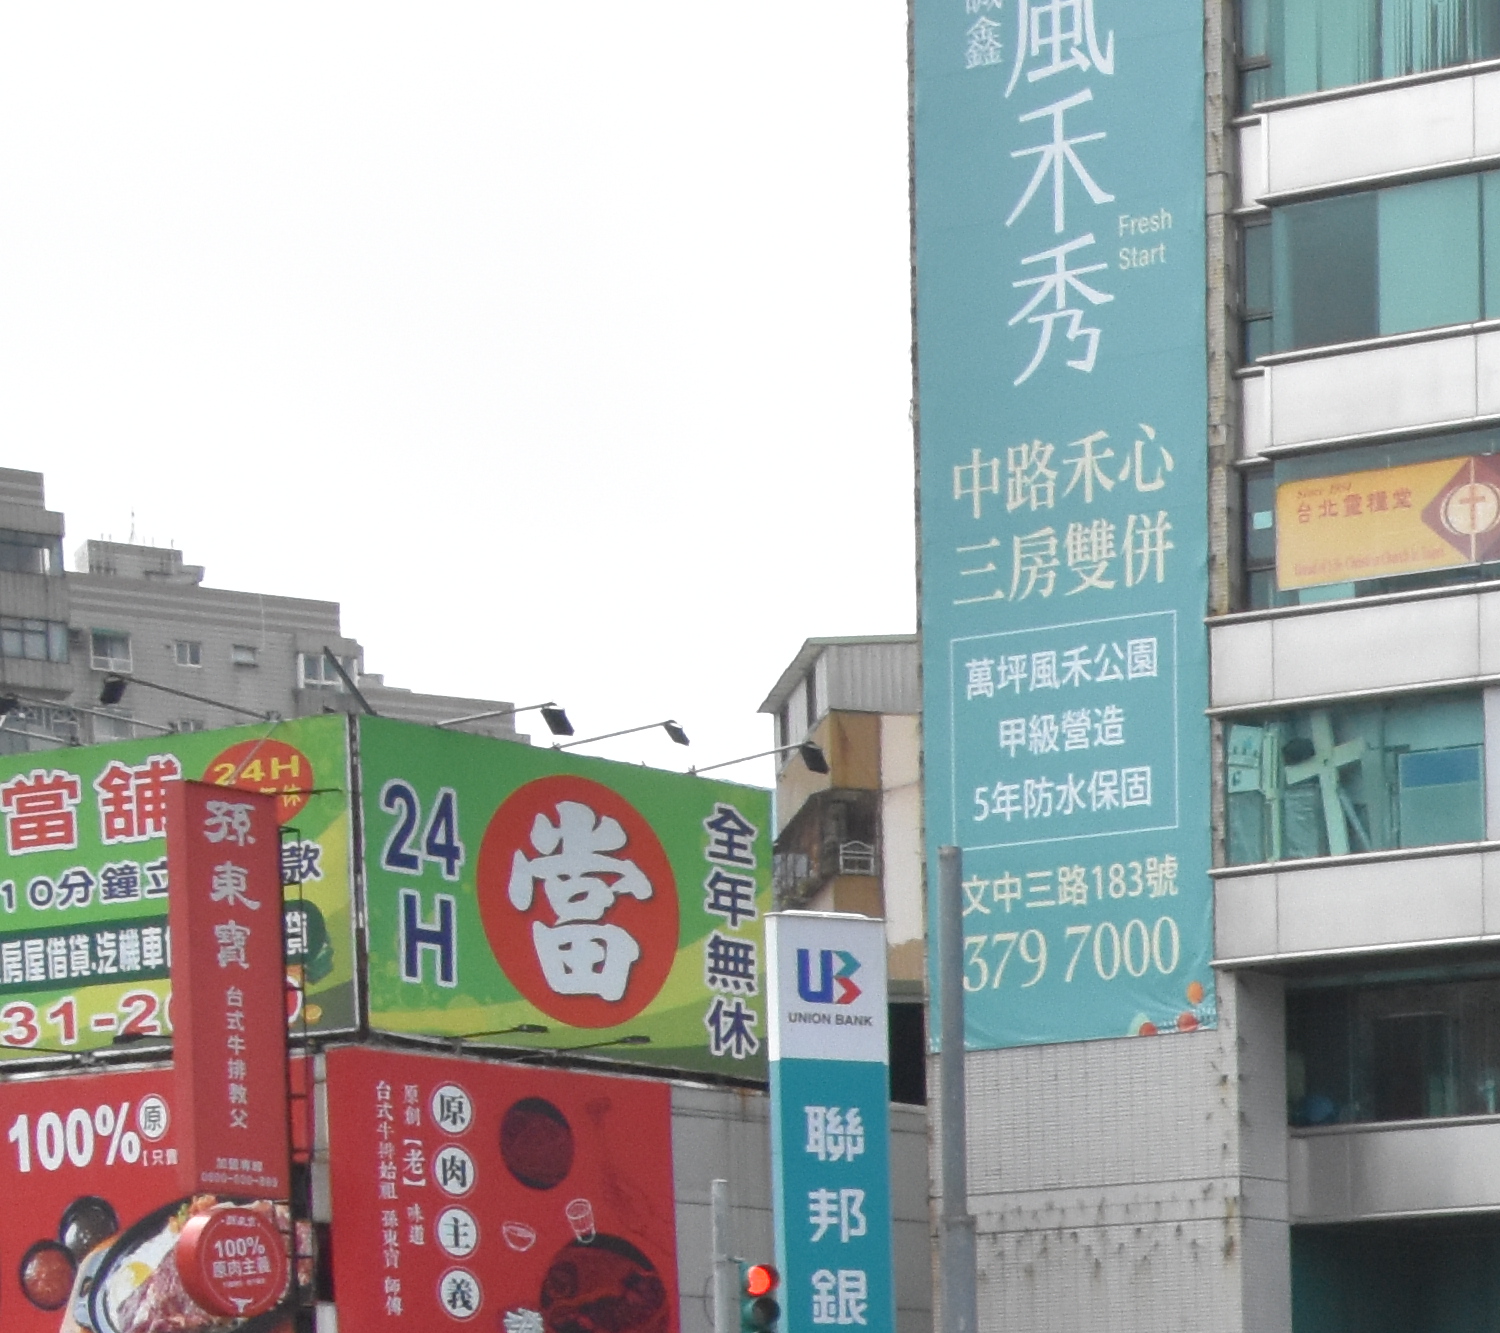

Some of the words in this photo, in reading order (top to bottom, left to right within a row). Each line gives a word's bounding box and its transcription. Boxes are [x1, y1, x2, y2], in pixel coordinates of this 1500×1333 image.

[964, 0, 1003, 69] 鑫
[1004, 0, 1115, 386] 風禾秀
[1118, 208, 1172, 238] Fresh
[1119, 243, 1167, 270] Start
[952, 423, 1175, 519] 中路禾心
[952, 510, 1175, 605] 三房雙併
[965, 636, 1159, 701] 萬坪風禾公園
[999, 705, 1126, 759] 甲級營造
[212, 754, 301, 787] 24H
[973, 766, 1152, 822] 5年防水保固
[382, 783, 464, 880] 24
[508, 799, 653, 1002] 當
[962, 853, 1179, 918] 文中三路183號
[401, 887, 459, 988] H
[703, 803, 759, 1060] 全年無休
[963, 928, 1047, 992] 379
[1064, 916, 1181, 984] 7000
[788, 1011, 832, 1026] UNION
[834, 1013, 873, 1028] BANK
[8, 1101, 142, 1174] 100%
[438, 1094, 477, 1313] 原肉主義
[214, 1236, 265, 1258] 100%
